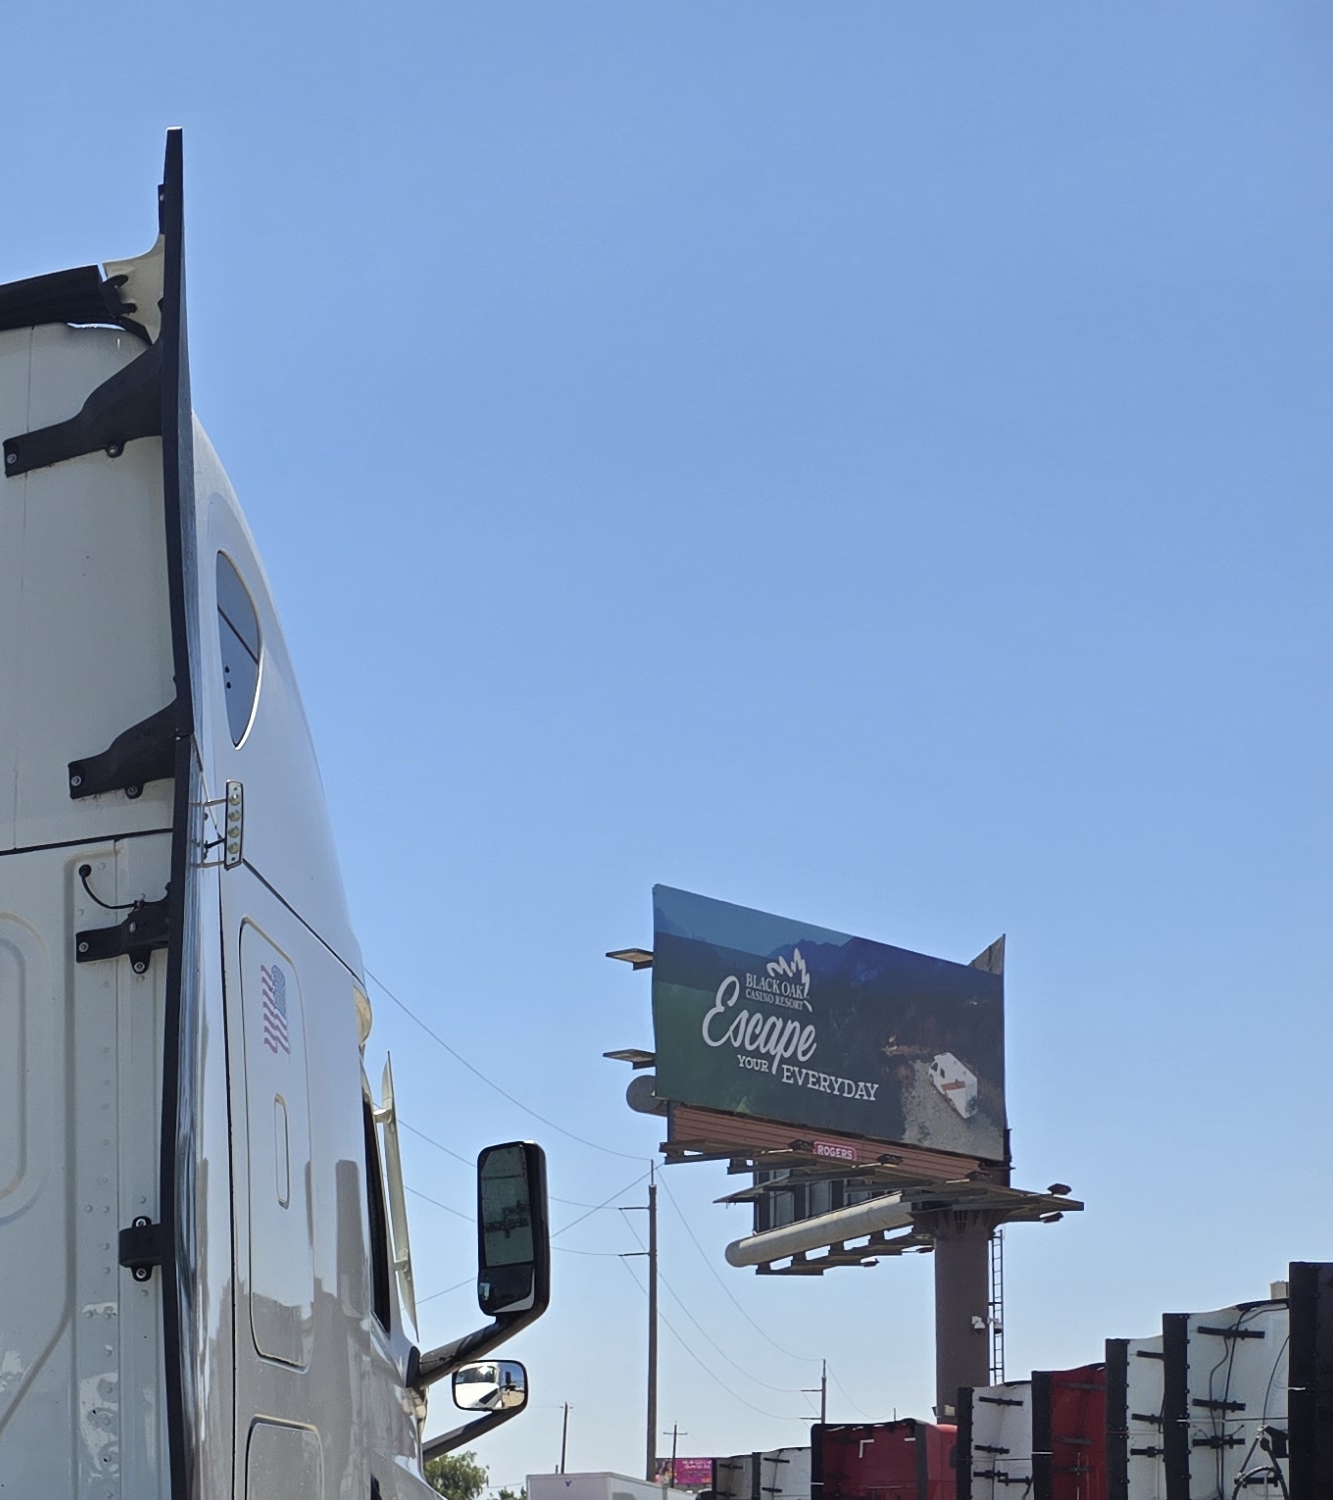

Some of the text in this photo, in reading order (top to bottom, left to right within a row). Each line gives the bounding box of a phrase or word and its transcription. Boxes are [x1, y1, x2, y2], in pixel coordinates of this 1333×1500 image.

[746, 973, 803, 999] BLACK OAK
[745, 988, 804, 1011] CASINO RESORT
[702, 975, 817, 1075] Escape
[737, 1055, 879, 1100] YOUR EVERYDAY
[817, 1145, 852, 1160] ROGERS
